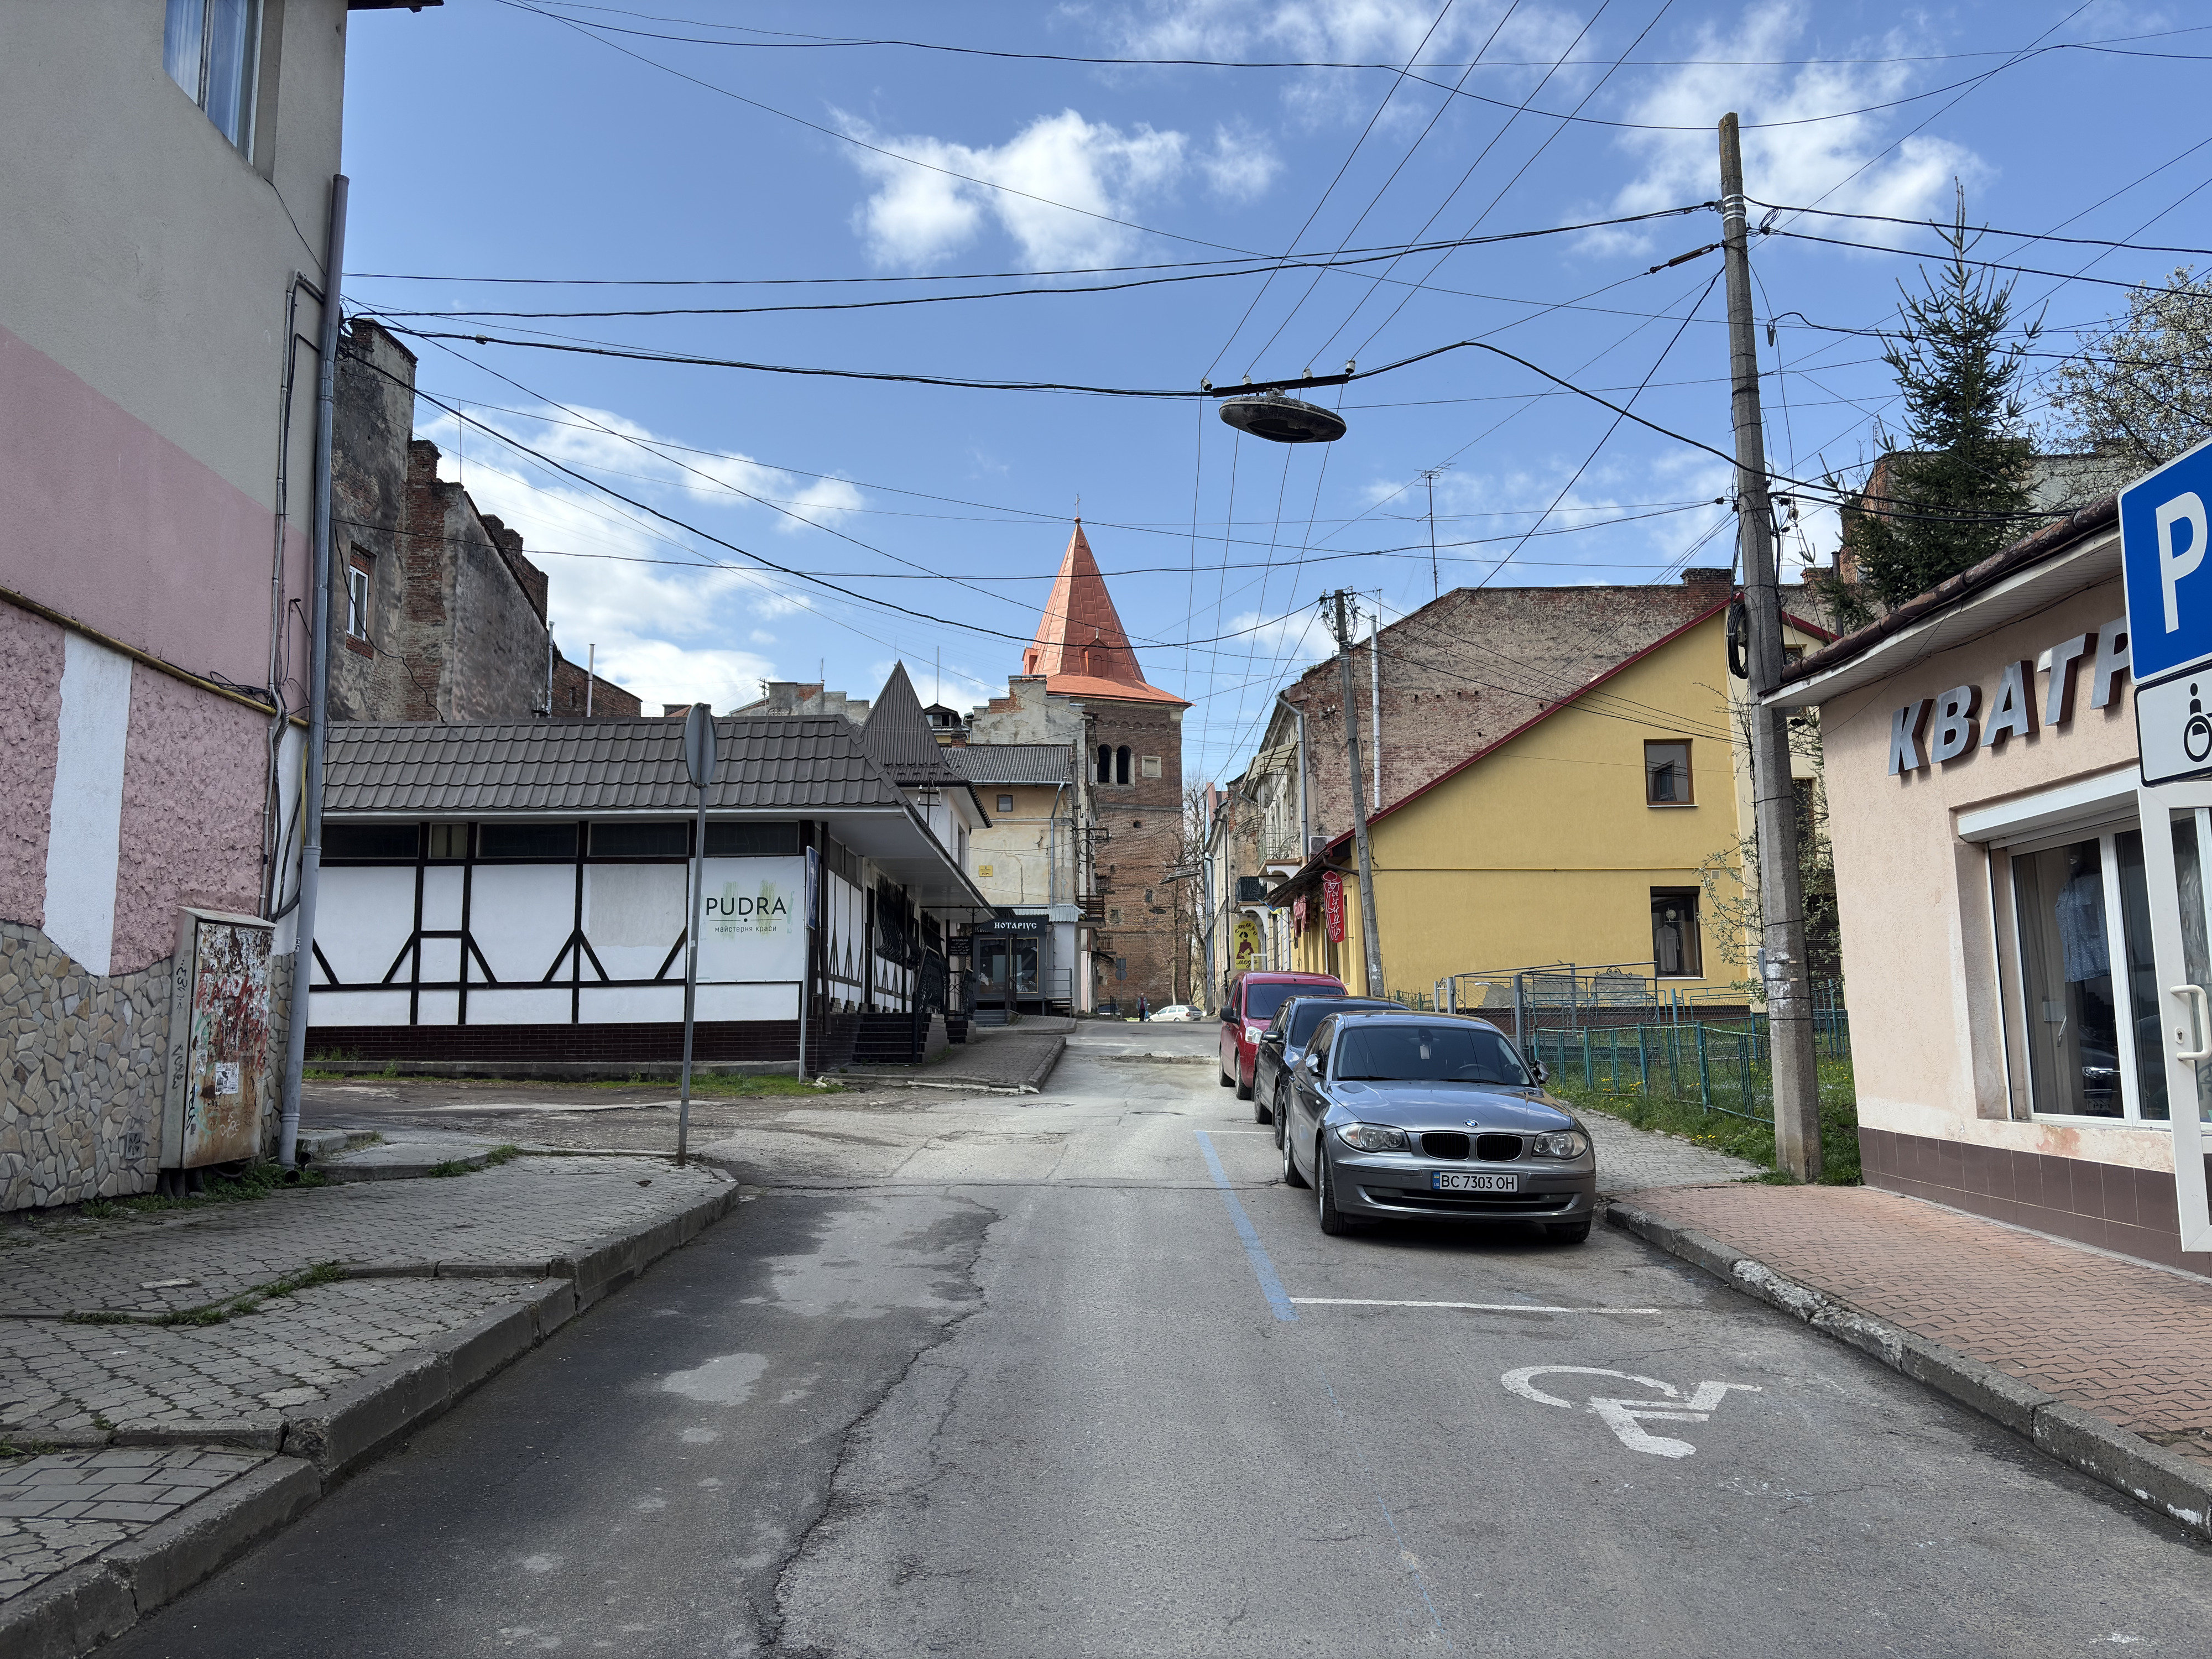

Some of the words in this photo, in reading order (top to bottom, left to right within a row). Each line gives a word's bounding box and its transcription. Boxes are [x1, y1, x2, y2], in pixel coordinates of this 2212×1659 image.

[2156, 492, 2208, 634] P
[706, 896, 787, 916] PUDRA
[1463, 1176, 1493, 1189] 7303
